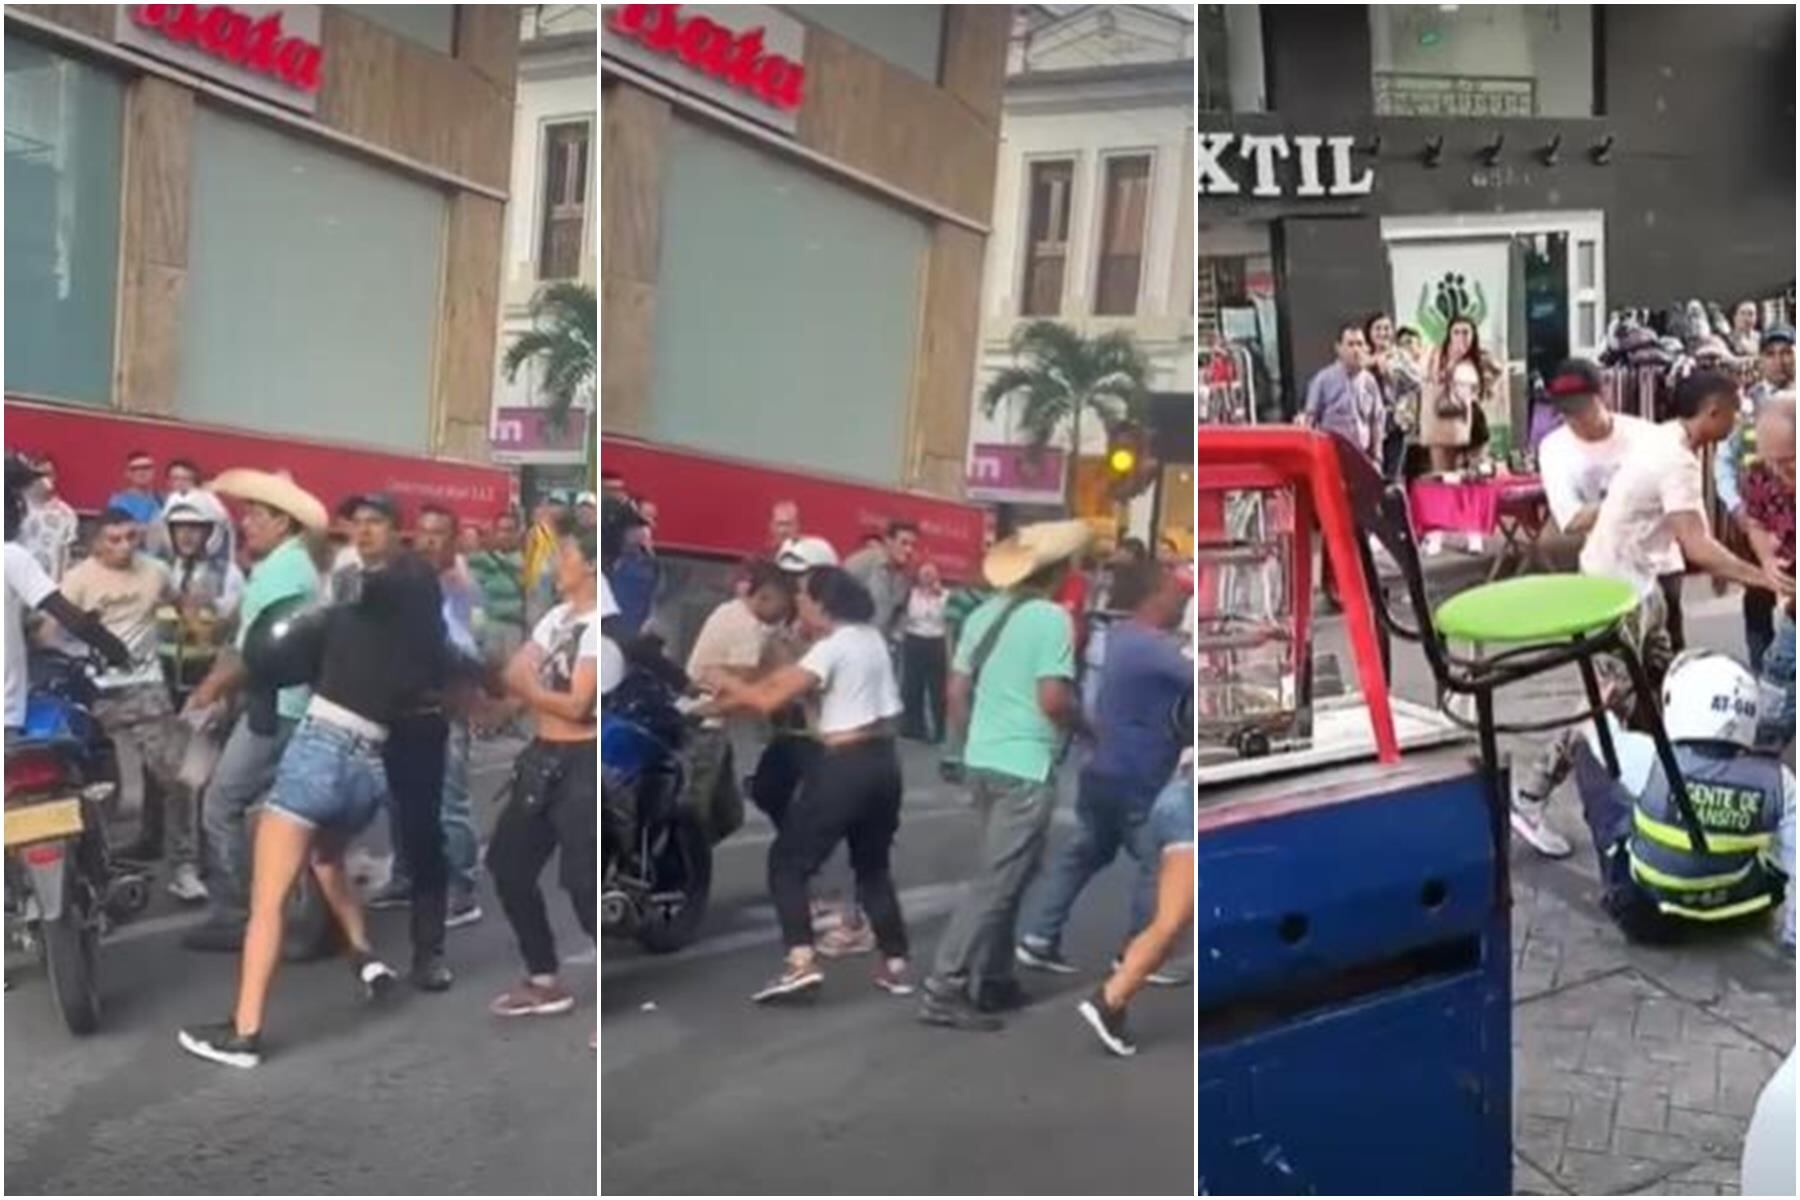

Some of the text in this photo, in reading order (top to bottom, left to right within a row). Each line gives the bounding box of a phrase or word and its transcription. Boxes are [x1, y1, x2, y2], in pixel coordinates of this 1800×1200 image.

[1198, 132, 1374, 196] XTIL
[1671, 782, 1762, 814] GENTE DE
[1677, 803, 1752, 831] ANSITO
